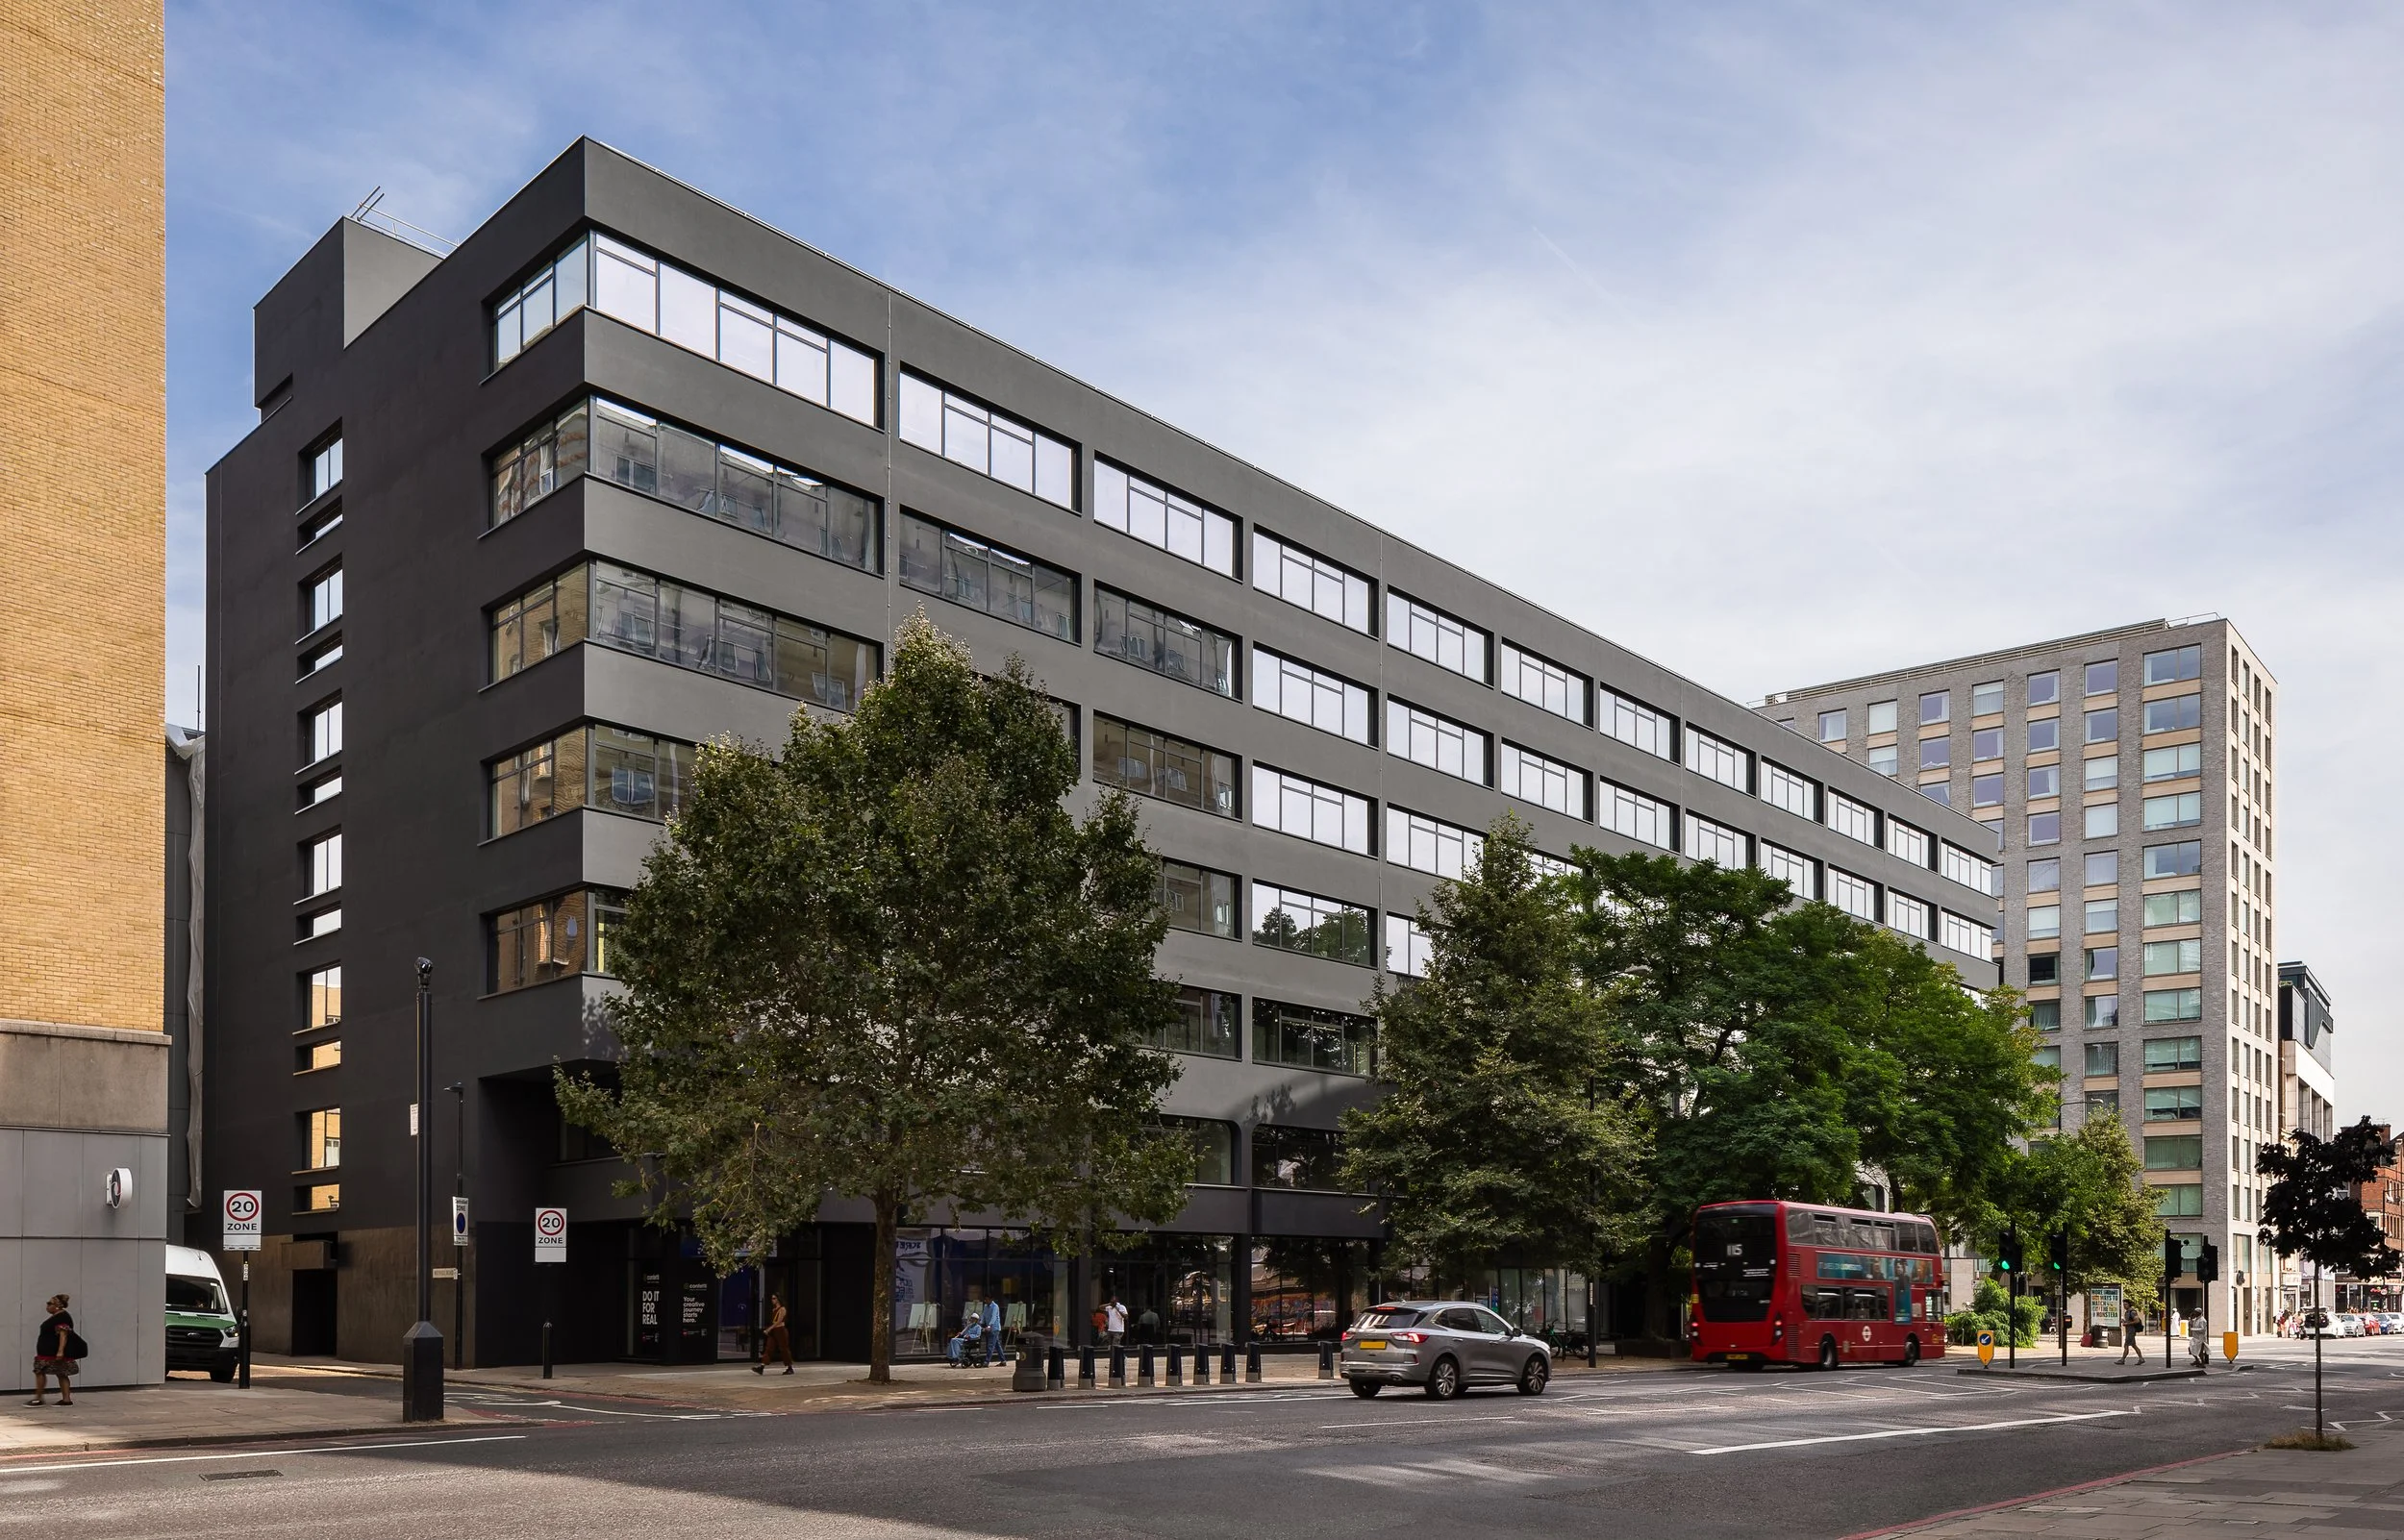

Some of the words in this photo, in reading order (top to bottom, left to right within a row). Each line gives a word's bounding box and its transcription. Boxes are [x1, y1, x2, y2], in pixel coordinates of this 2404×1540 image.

[232, 1201, 254, 1213] 20
[542, 1217, 561, 1228] 20
[642, 1291, 653, 1302] DO
[654, 1291, 660, 1302] IT
[642, 1303, 655, 1313] FOR
[642, 1314, 658, 1325] REAL
